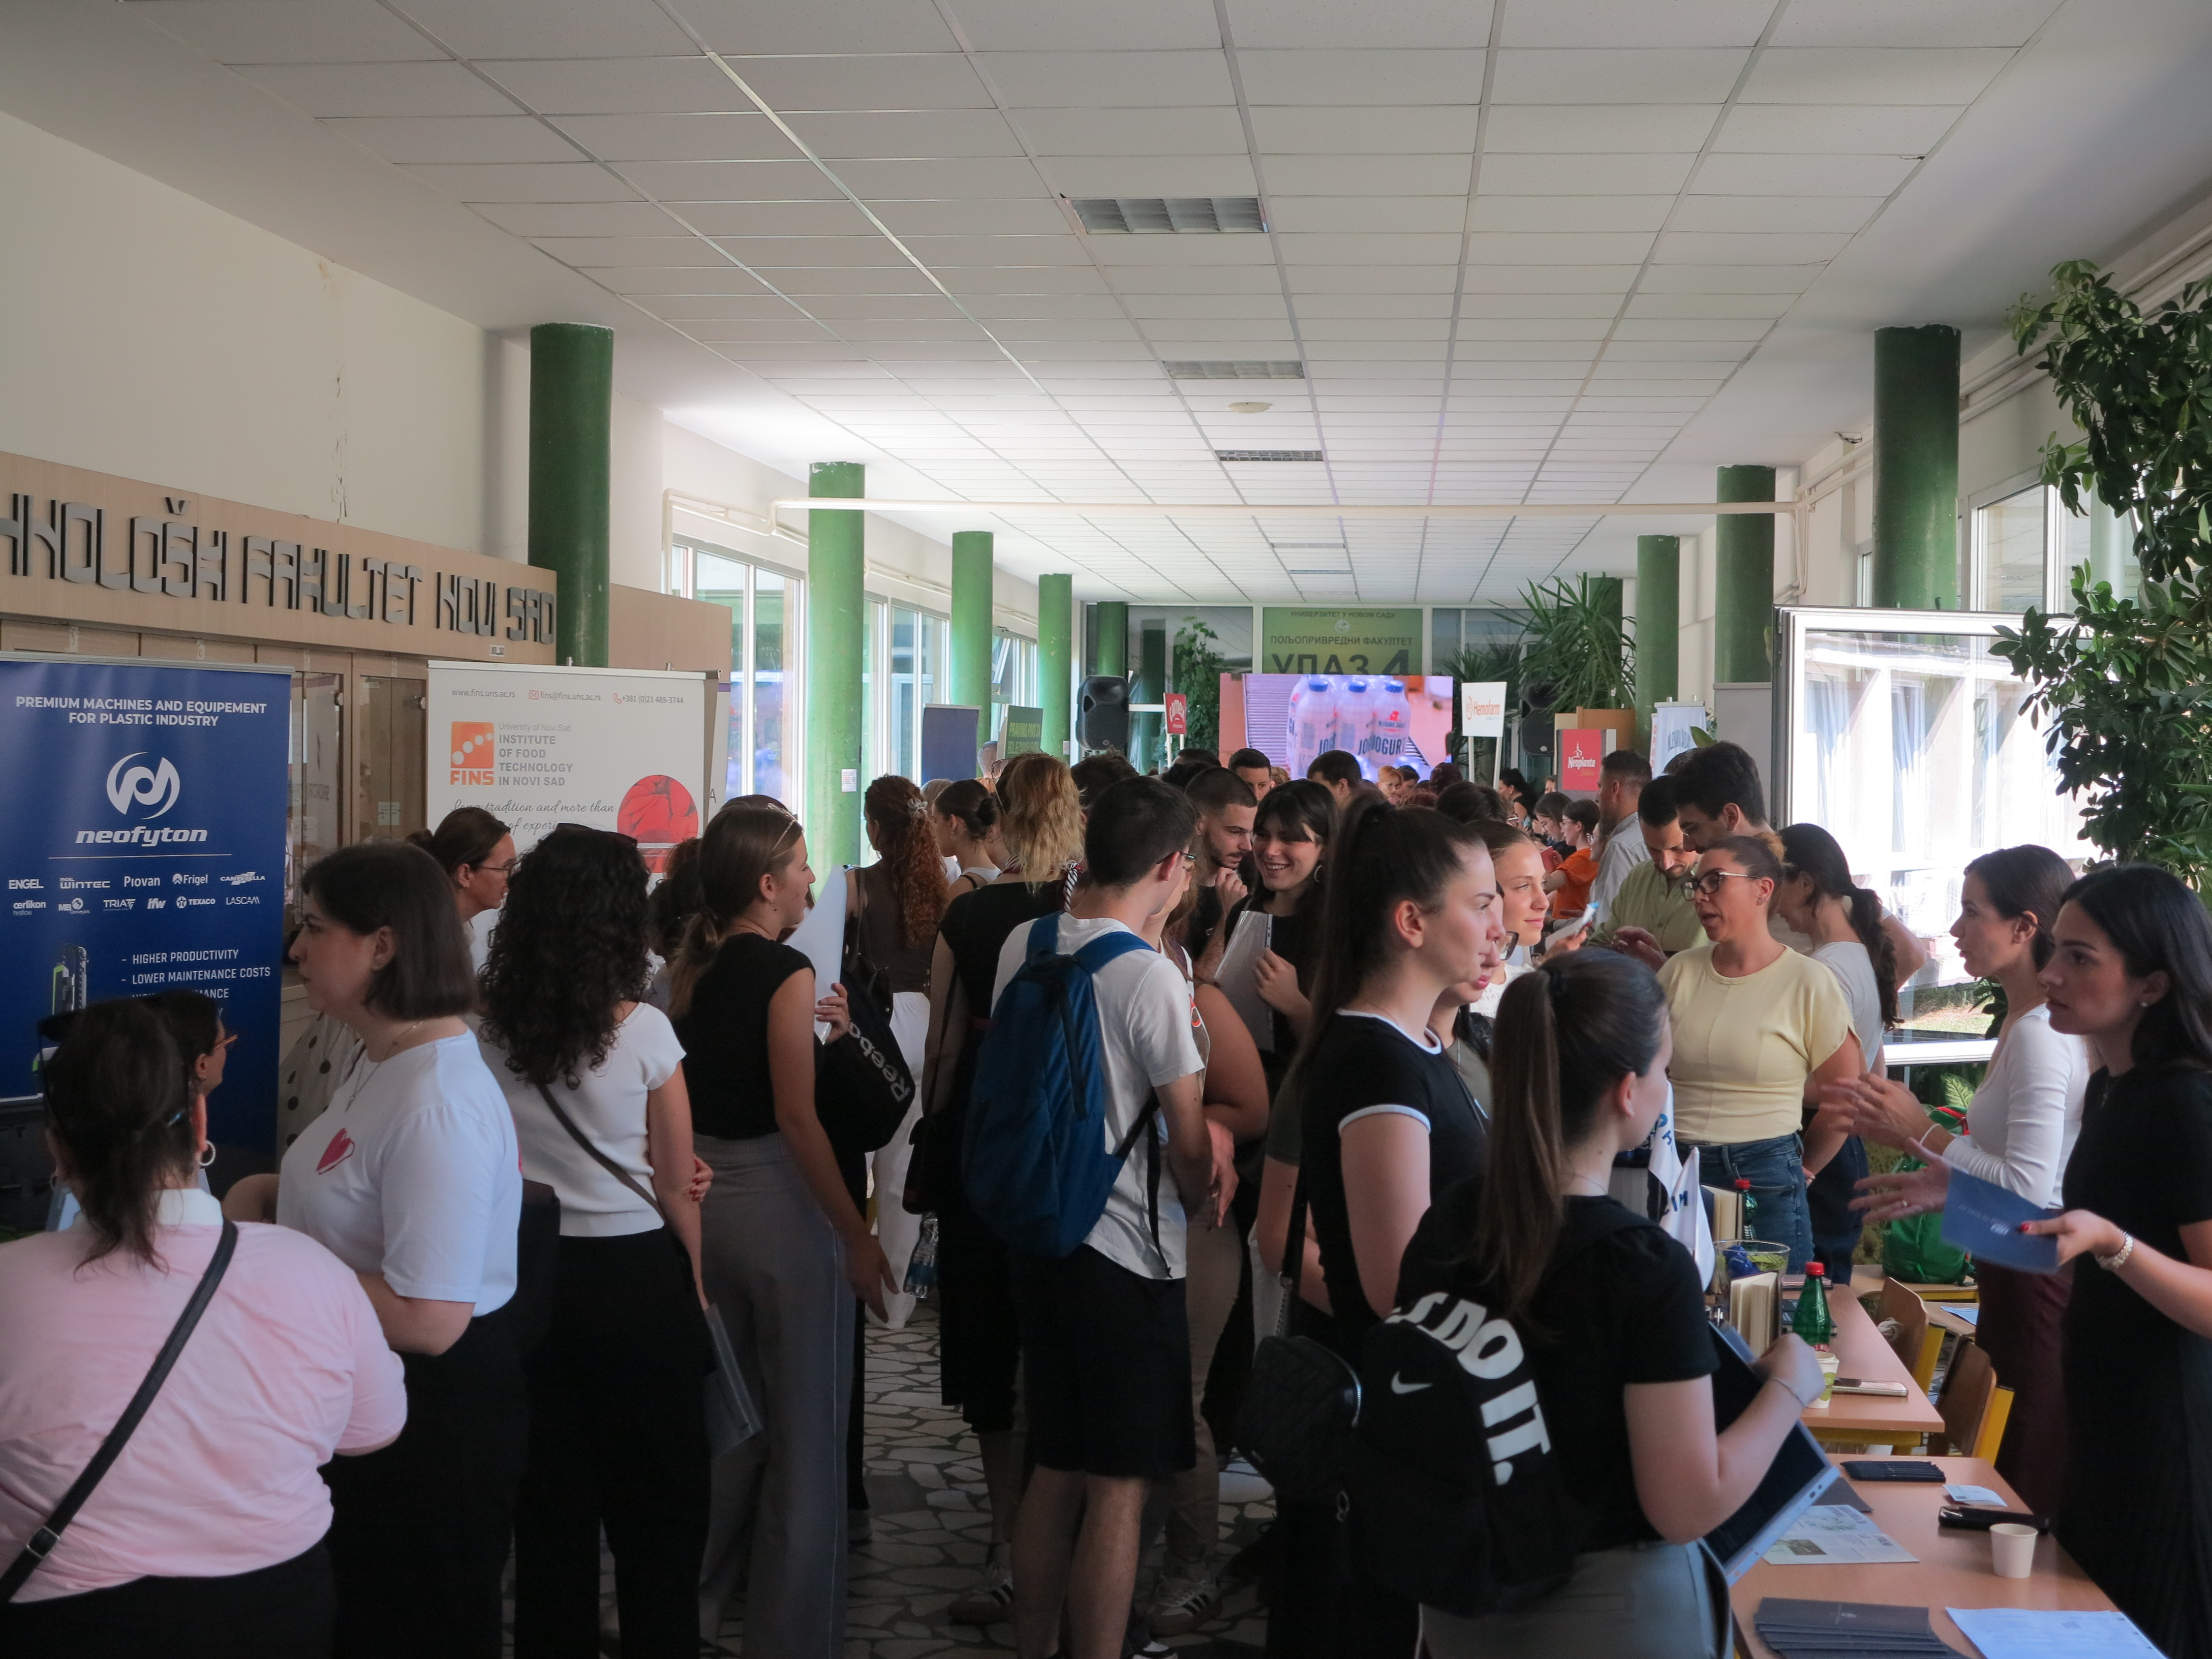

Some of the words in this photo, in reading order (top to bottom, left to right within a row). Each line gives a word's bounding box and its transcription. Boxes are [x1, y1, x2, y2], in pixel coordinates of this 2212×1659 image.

[242, 535, 423, 626] FAKULTET
[436, 572, 497, 636] NOVI
[507, 587, 555, 644] SAD
[1271, 636, 1360, 645] ПОЉОПРИВРЕДНИ
[1363, 637, 1412, 646] ФАКУЛТЕТ
[1381, 649, 1411, 675] 4
[452, 689, 515, 698] www.fins.uns.ac.rs
[540, 691, 601, 701] fins@fins.uns.ac.rs
[638, 695, 654, 703] (0)21
[655, 695, 684, 703] 485-3744
[16, 696, 80, 709] PREMIUM
[83, 698, 152, 711] MACHINES
[155, 700, 183, 712] AND
[187, 701, 267, 714] EQUIPEMENT
[69, 712, 96, 723] FOR
[100, 713, 152, 725] PLASTIC
[156, 715, 219, 726] INDUSTRY
[499, 723, 530, 732] University
[499, 735, 556, 744] INSTITUTE
[499, 749, 513, 757] OF
[516, 749, 546, 758] FOOD
[499, 762, 573, 772] TECHNOLOGY
[1568, 757, 1595, 770] Neoplanta
[450, 771, 494, 785] FINS
[499, 777, 509, 785] IN
[513, 777, 540, 786] NOVI
[544, 777, 565, 786] SAD
[485, 800, 533, 812] tradition
[536, 800, 561, 812] and
[590, 800, 615, 812] than
[509, 817, 523, 835] of
[523, 821, 557, 835] experi
[75, 826, 208, 847] neofyton
[9, 879, 44, 889] ENGEL
[183, 874, 208, 886] Frigel
[133, 953, 167, 965] HIGHER
[170, 949, 239, 962] PRODUCTIVITY
[132, 973, 165, 984] LOWER
[168, 969, 237, 982] MAINTENANCE
[240, 967, 271, 978] COSTS
[849, 1021, 910, 1103] Reebo
